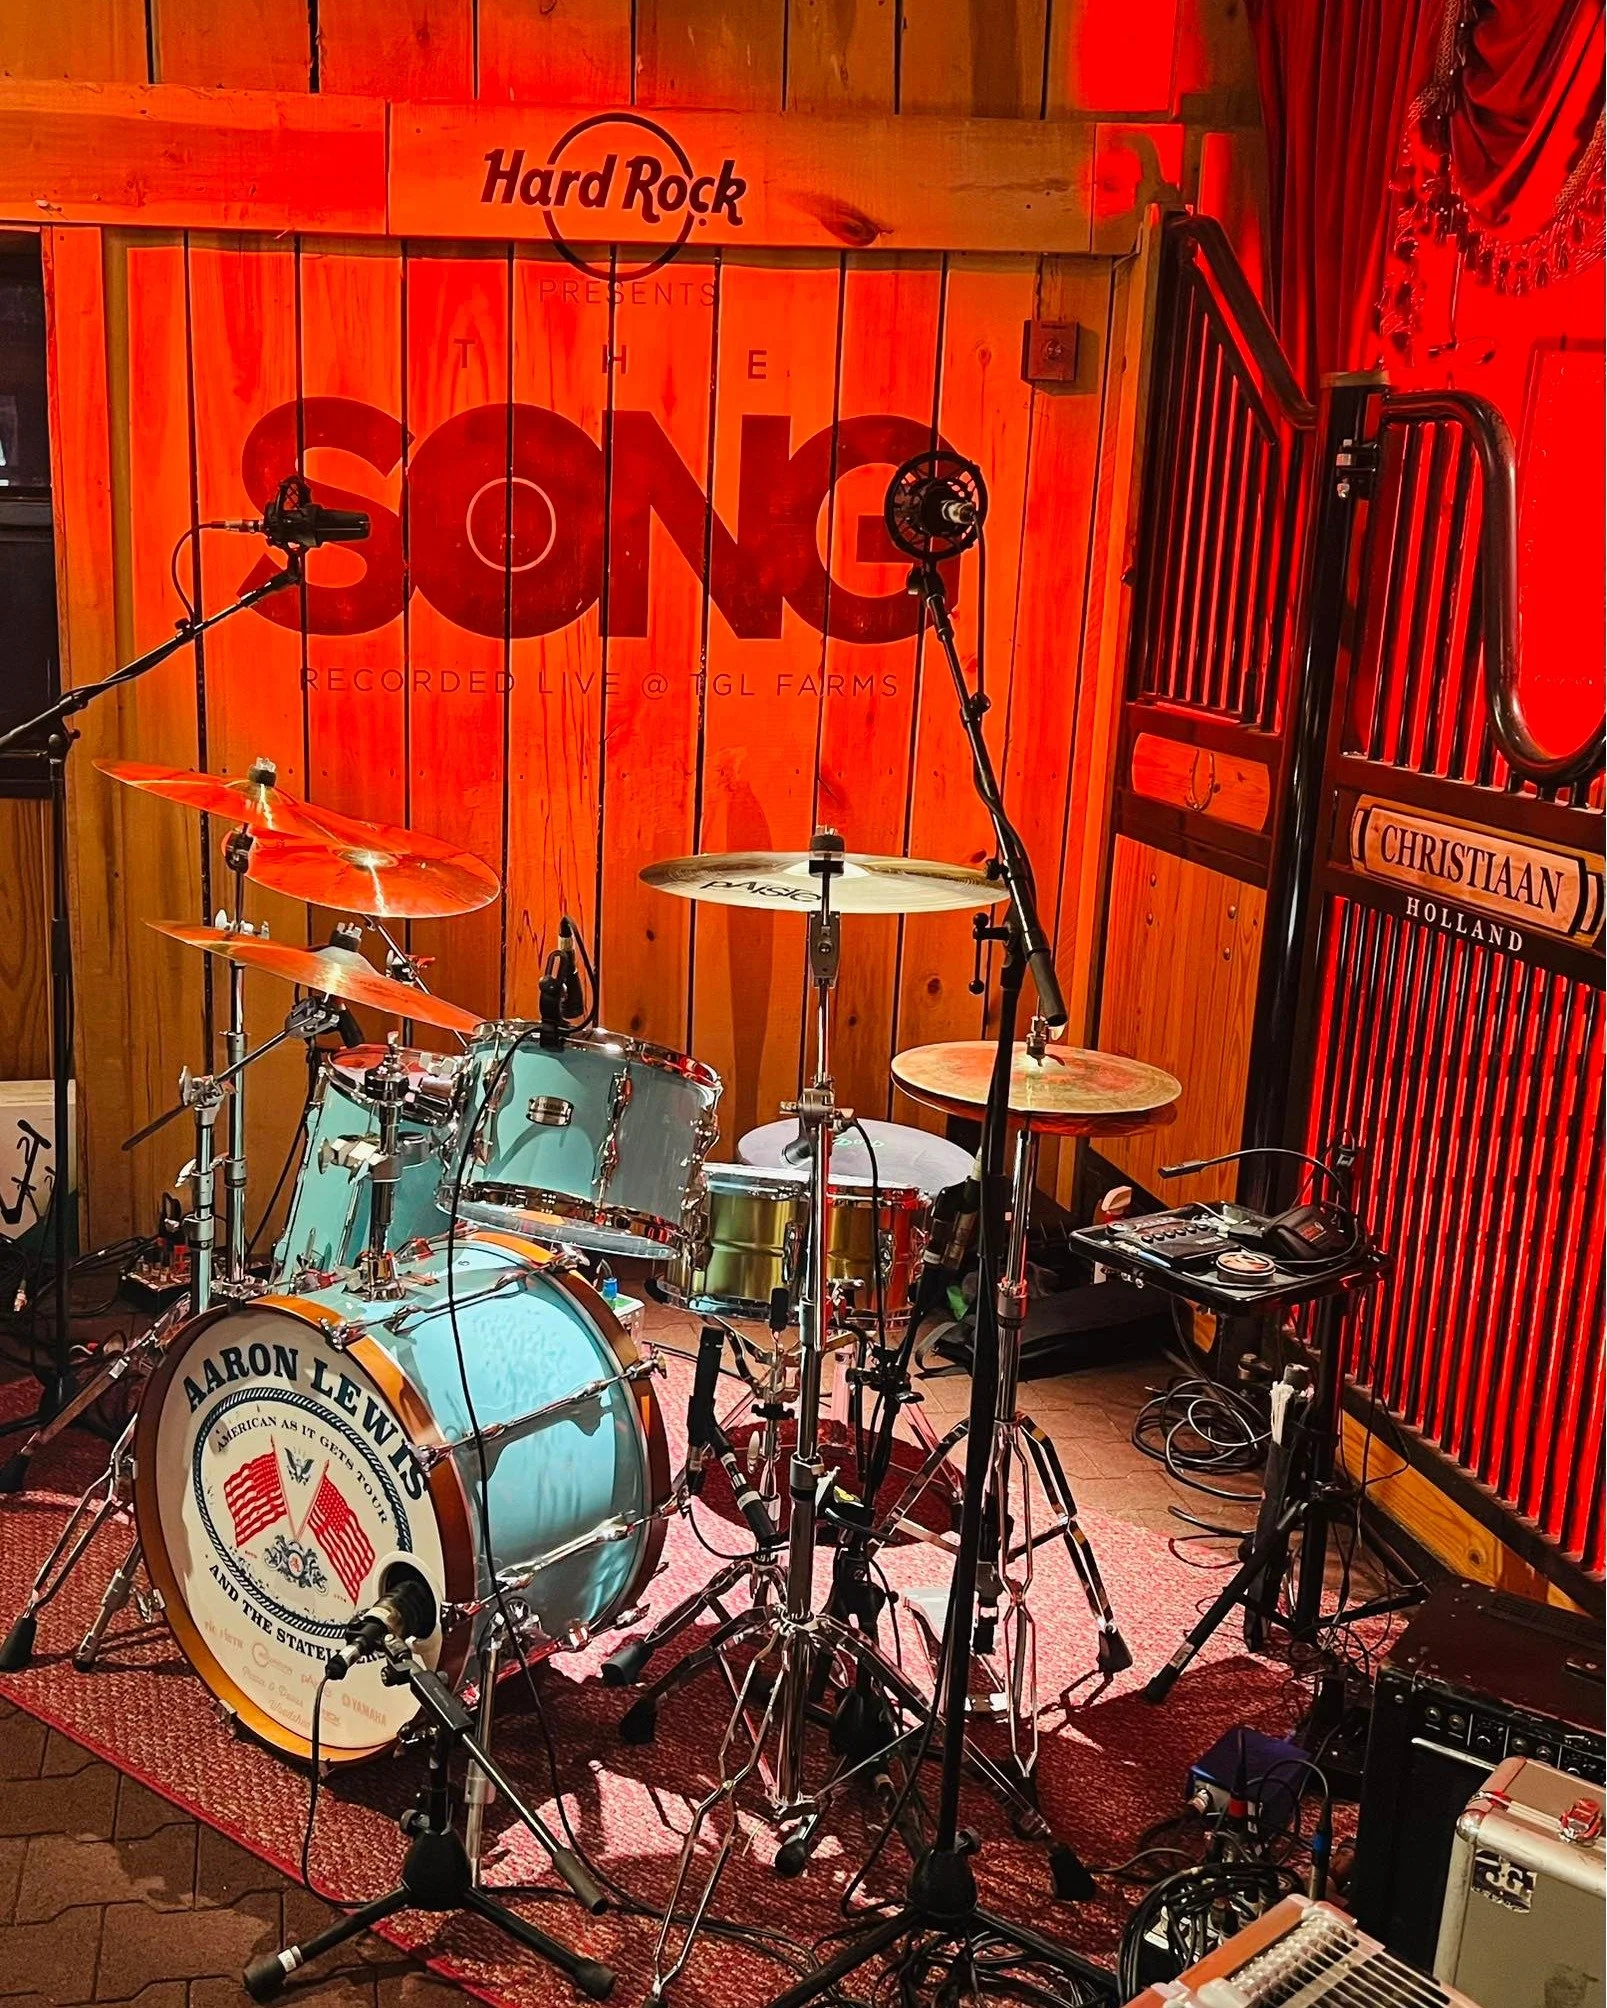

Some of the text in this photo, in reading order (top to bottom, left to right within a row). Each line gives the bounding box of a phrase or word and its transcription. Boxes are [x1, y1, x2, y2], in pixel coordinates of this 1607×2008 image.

[480, 149, 747, 227] Hard Rock
[538, 279, 718, 307] PRESENTS
[235, 396, 963, 645] SONG
[300, 667, 898, 700] RECORDED LIVE @ TGL FARMS
[1380, 824, 1565, 914] CHRISTIAAN
[1406, 896, 1523, 952] HOLLAND
[182, 1342, 429, 1501] AARON LEWIS
[216, 1416, 388, 1525] AMERICAN AS IT GETS TOUR
[208, 1563, 240, 1602] AND
[242, 1599, 272, 1636] THE
